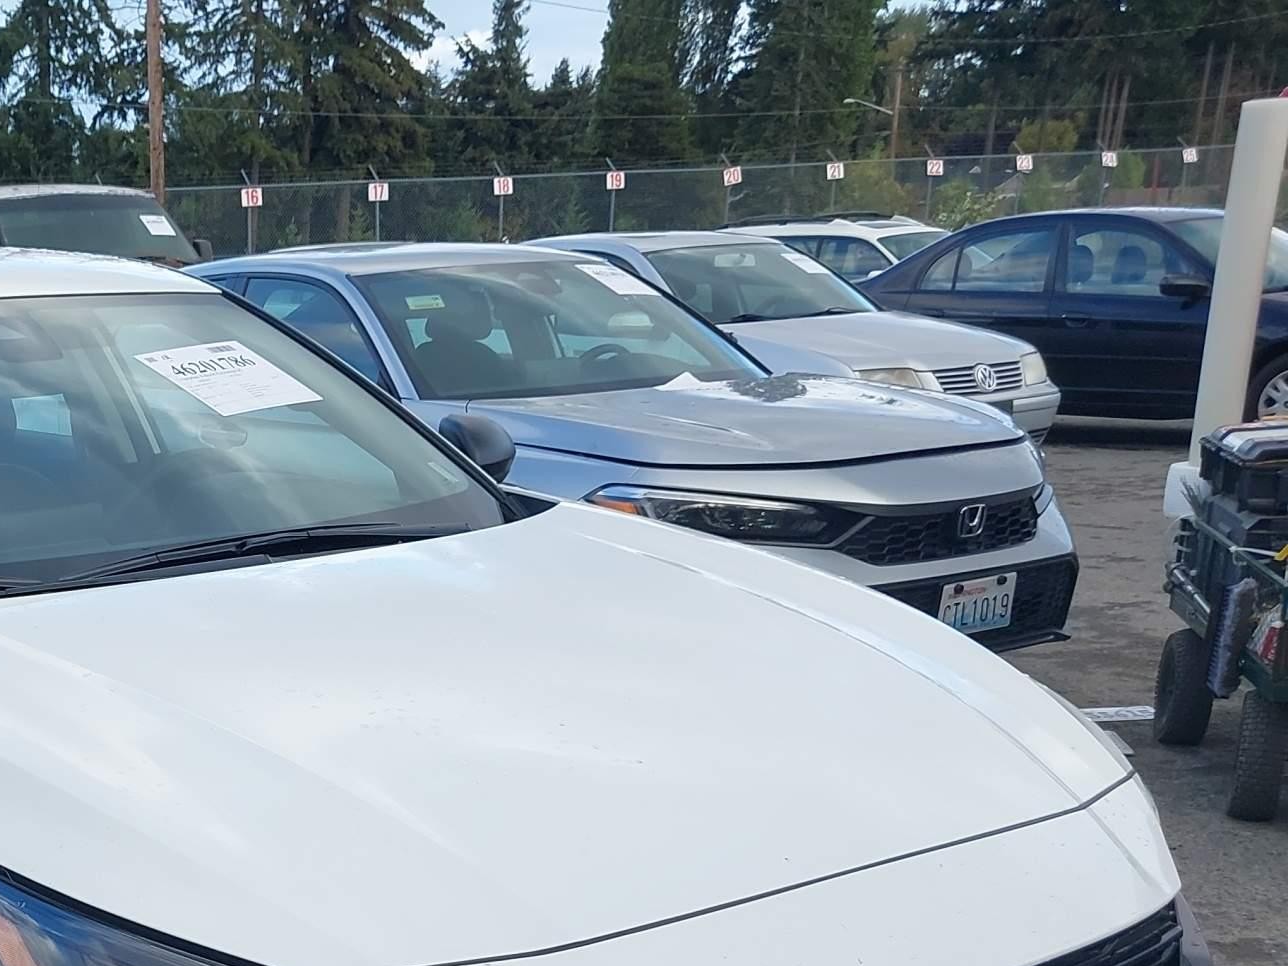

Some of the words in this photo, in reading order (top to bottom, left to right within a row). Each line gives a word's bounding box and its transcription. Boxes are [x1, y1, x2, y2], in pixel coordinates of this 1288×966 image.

[1017, 156, 1030, 169] 23
[1183, 150, 1196, 162] 25
[829, 164, 842, 179] 21
[928, 161, 941, 174] 22
[609, 173, 622, 188] 19
[724, 168, 740, 183] 20
[372, 184, 385, 200] 17
[497, 178, 510, 193] 18
[245, 189, 259, 205] 16
[171, 355, 257, 376] 46201786
